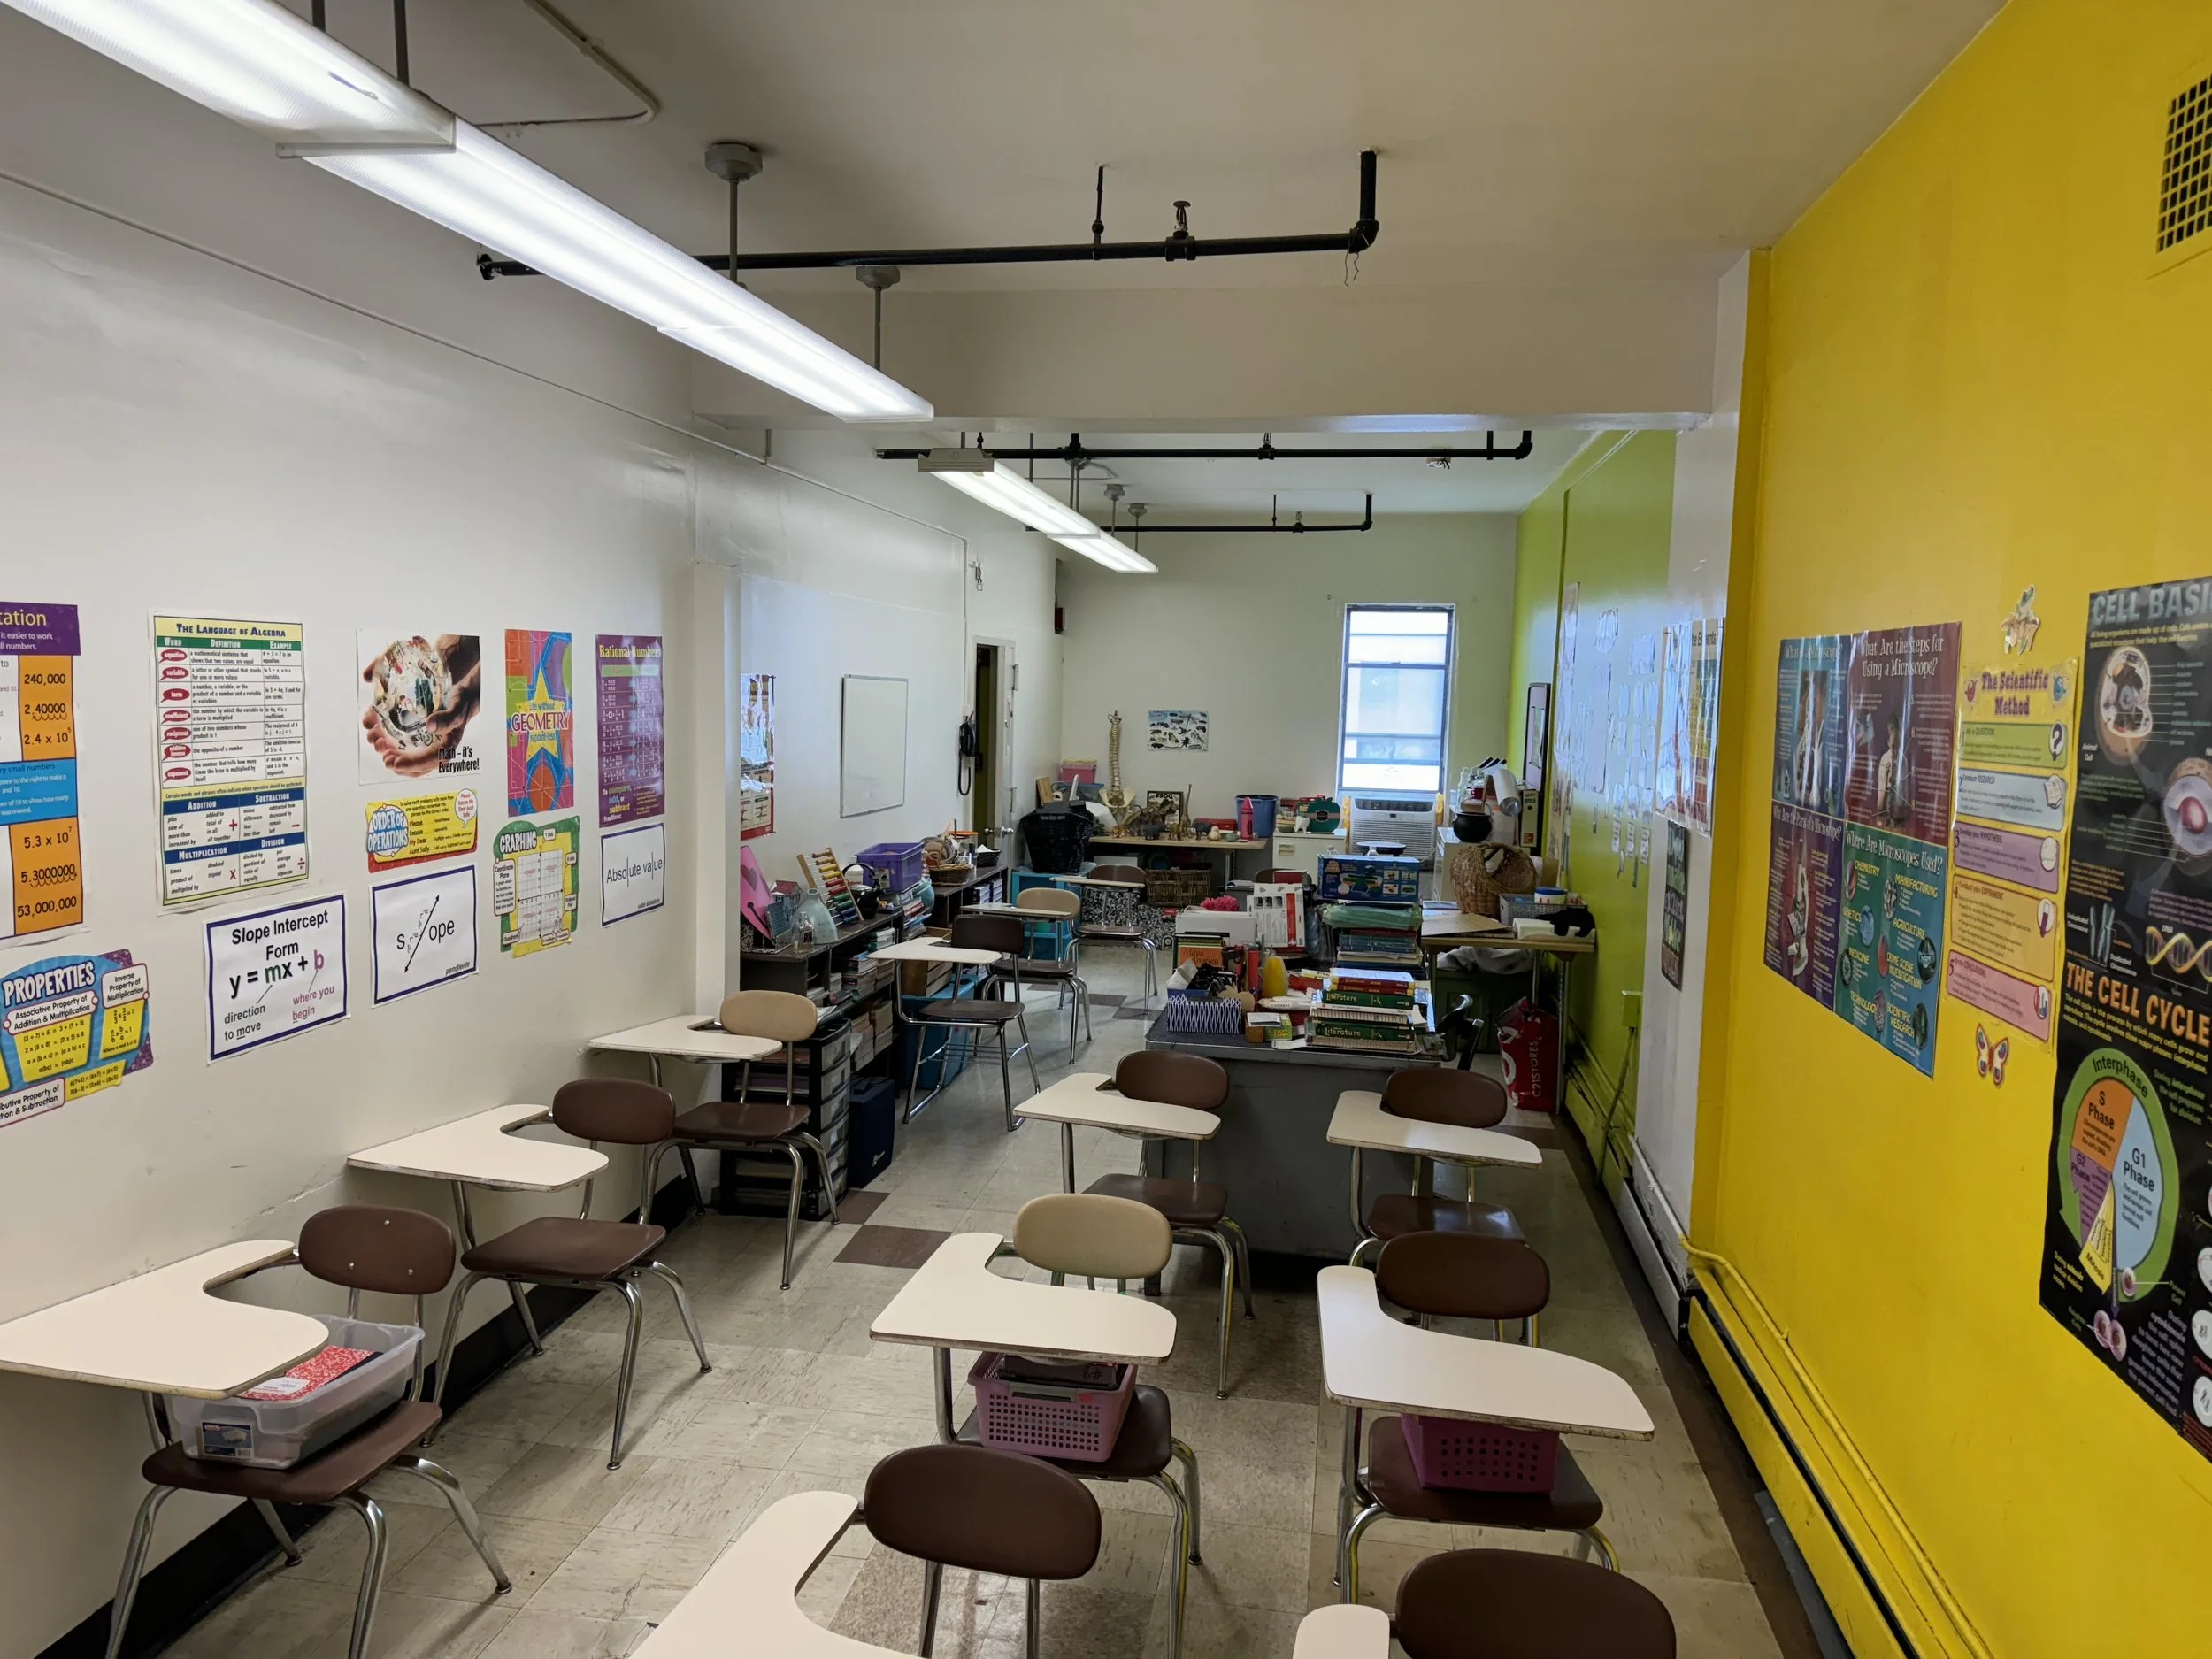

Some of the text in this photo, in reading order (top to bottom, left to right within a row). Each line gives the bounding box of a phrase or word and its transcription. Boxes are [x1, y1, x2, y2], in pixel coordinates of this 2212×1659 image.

[2092, 581, 2212, 626] CELL BASI
[5, 641, 38, 650] numbers.
[36, 632, 54, 641] work
[1879, 638, 1893, 657] Are
[1894, 638, 1908, 655] the
[1932, 634, 1944, 652] for
[599, 644, 662, 658] Rational Numbers
[1, 659, 10, 668] to
[1862, 660, 1883, 680] Using
[1885, 664, 1889, 676] a
[24, 673, 66, 687] 240,000
[1981, 668, 2049, 690] The Scientific
[24, 703, 66, 715] 2.40000
[1994, 695, 2030, 716] Method
[511, 711, 569, 733] GEOMETRY
[24, 733, 42, 745] 2.4
[438, 745, 473, 760] Math it's
[7, 763, 56, 773] small numbers
[438, 757, 480, 774] Everywhere!
[609, 803, 630, 815] subtract
[373, 810, 404, 831] ORDER OF
[24, 835, 42, 849] 5.3
[367, 829, 408, 853] OPERATIONS
[499, 831, 537, 854] GRAPHING
[1955, 829, 1961, 848] 3
[1846, 830, 1866, 849] Where
[1865, 834, 1878, 853] Are
[1878, 838, 1920, 868] Microscopes
[1921, 850, 1943, 876] Used?
[20, 863, 76, 883] 5.3000000
[606, 855, 663, 886] Absolute value
[1894, 873, 1939, 899] MANUFACTURING
[18, 895, 77, 918] 53,000,000
[231, 910, 329, 945] Slope Intercept
[265, 941, 299, 961] Form
[229, 974, 242, 1000] y
[265, 961, 293, 984] mx
[313, 949, 325, 971] b
[445, 960, 471, 977] pendiente
[1948, 958, 1955, 976] 5
[3, 961, 96, 1008] PROPERTIES
[109, 980, 134, 993] Property
[114, 972, 135, 983] Inverse
[107, 987, 144, 1002] Multiplication
[293, 986, 334, 1006] where you
[1326, 992, 1357, 1002] Literature
[2066, 961, 2095, 999] THE
[2097, 975, 2140, 1018] CELL
[2146, 994, 2211, 1048] CYCLE
[13, 1019, 42, 1031] Addition
[50, 1004, 90, 1023] Multiplication
[15, 1005, 51, 1020] Associative
[51, 997, 81, 1010] Property
[224, 1003, 266, 1025] direction
[292, 1005, 316, 1022] begin
[224, 1021, 262, 1041] to move
[1325, 1026, 1361, 1037] Literature
[2092, 1056, 2148, 1098] Interphase
[23, 1084, 60, 1103] Property of
[2098, 1090, 2106, 1106] S
[21, 1095, 58, 1113] Subtraction
[2088, 1102, 2116, 1130] Phase
[2076, 1153, 2085, 1168] G2
[2131, 1148, 2146, 1169] G1
[2070, 1161, 2091, 1183] Phase
[2124, 1160, 2155, 1193] Phase
[2085, 1252, 2105, 1281] Mitosis
